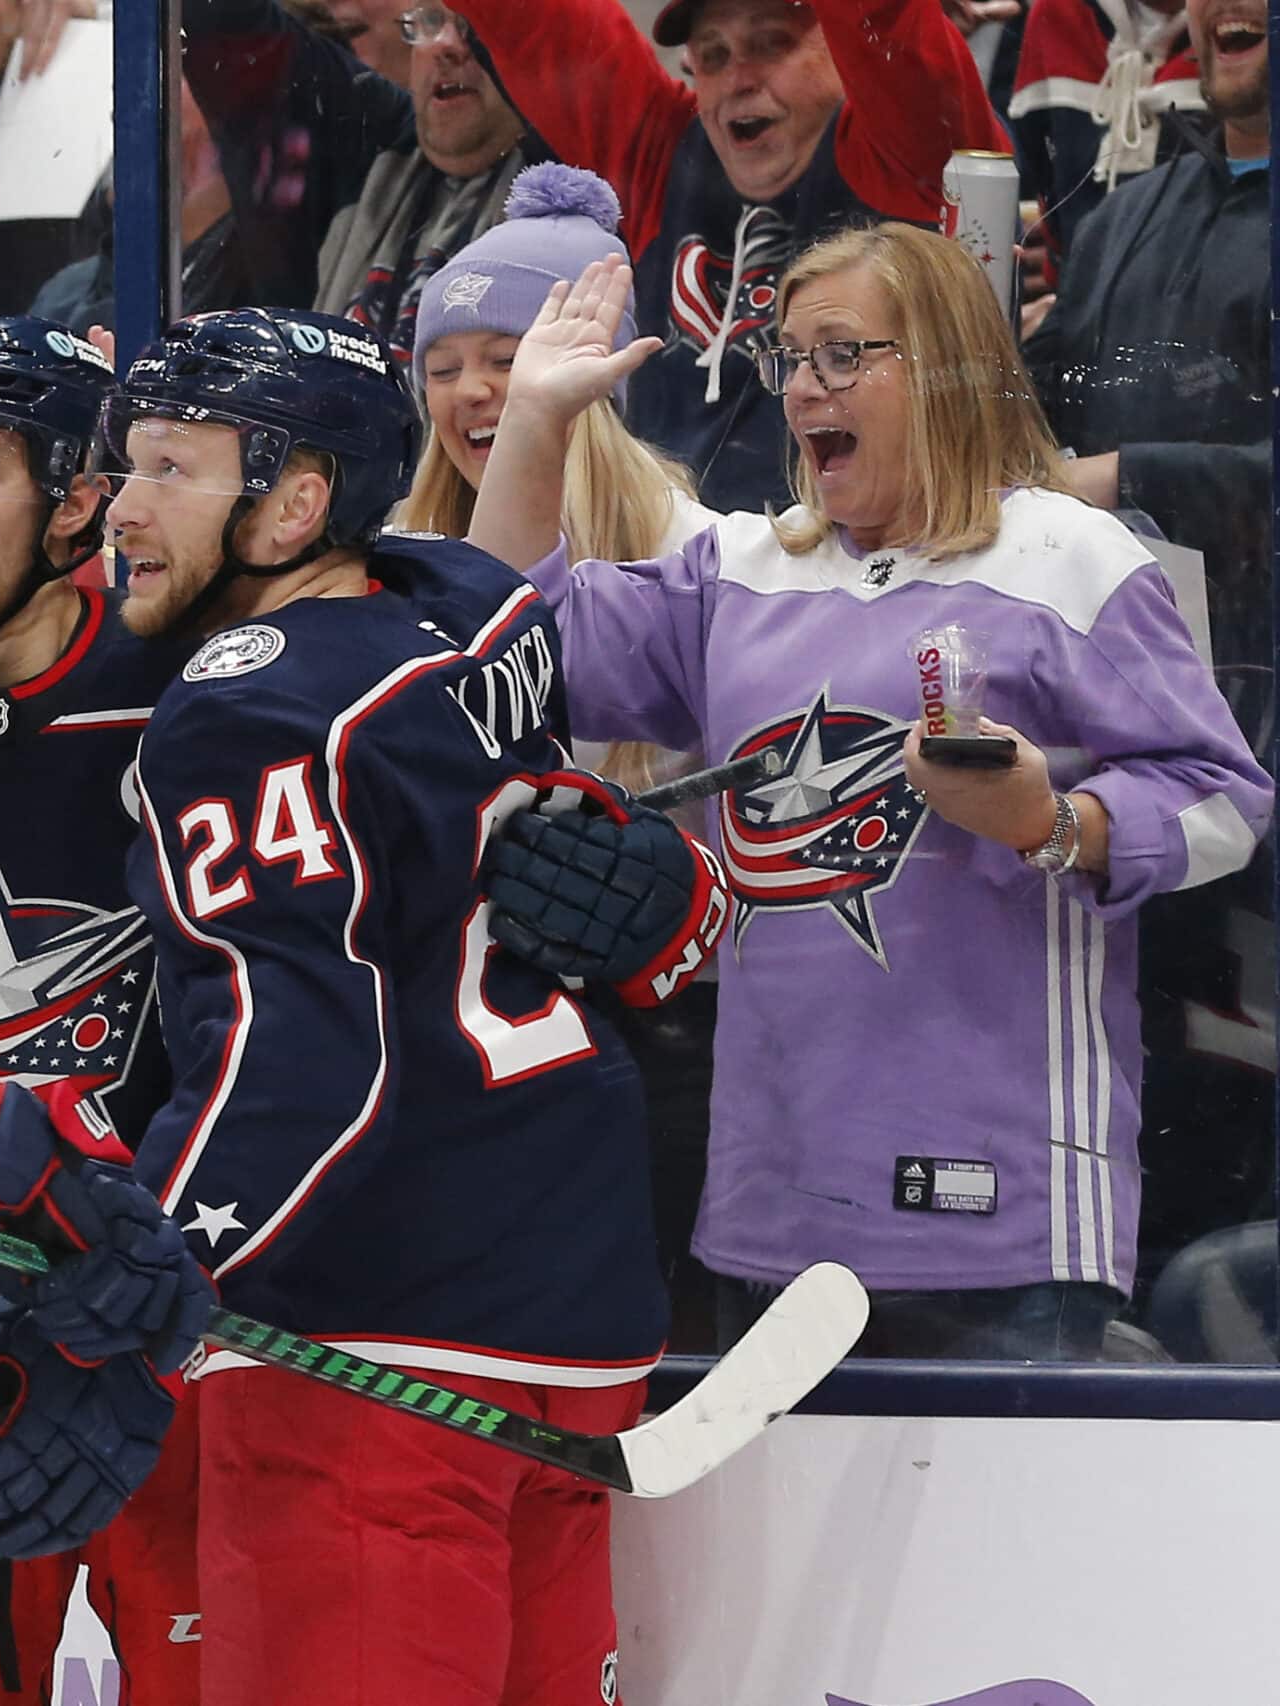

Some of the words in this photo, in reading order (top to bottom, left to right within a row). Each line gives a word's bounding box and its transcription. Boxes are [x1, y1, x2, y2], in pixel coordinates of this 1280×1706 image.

[327, 328, 381, 359] bread
[917, 647, 947, 736] ROCKS
[176, 754, 347, 921] 24
[219, 1314, 509, 1434] ARRIOR
